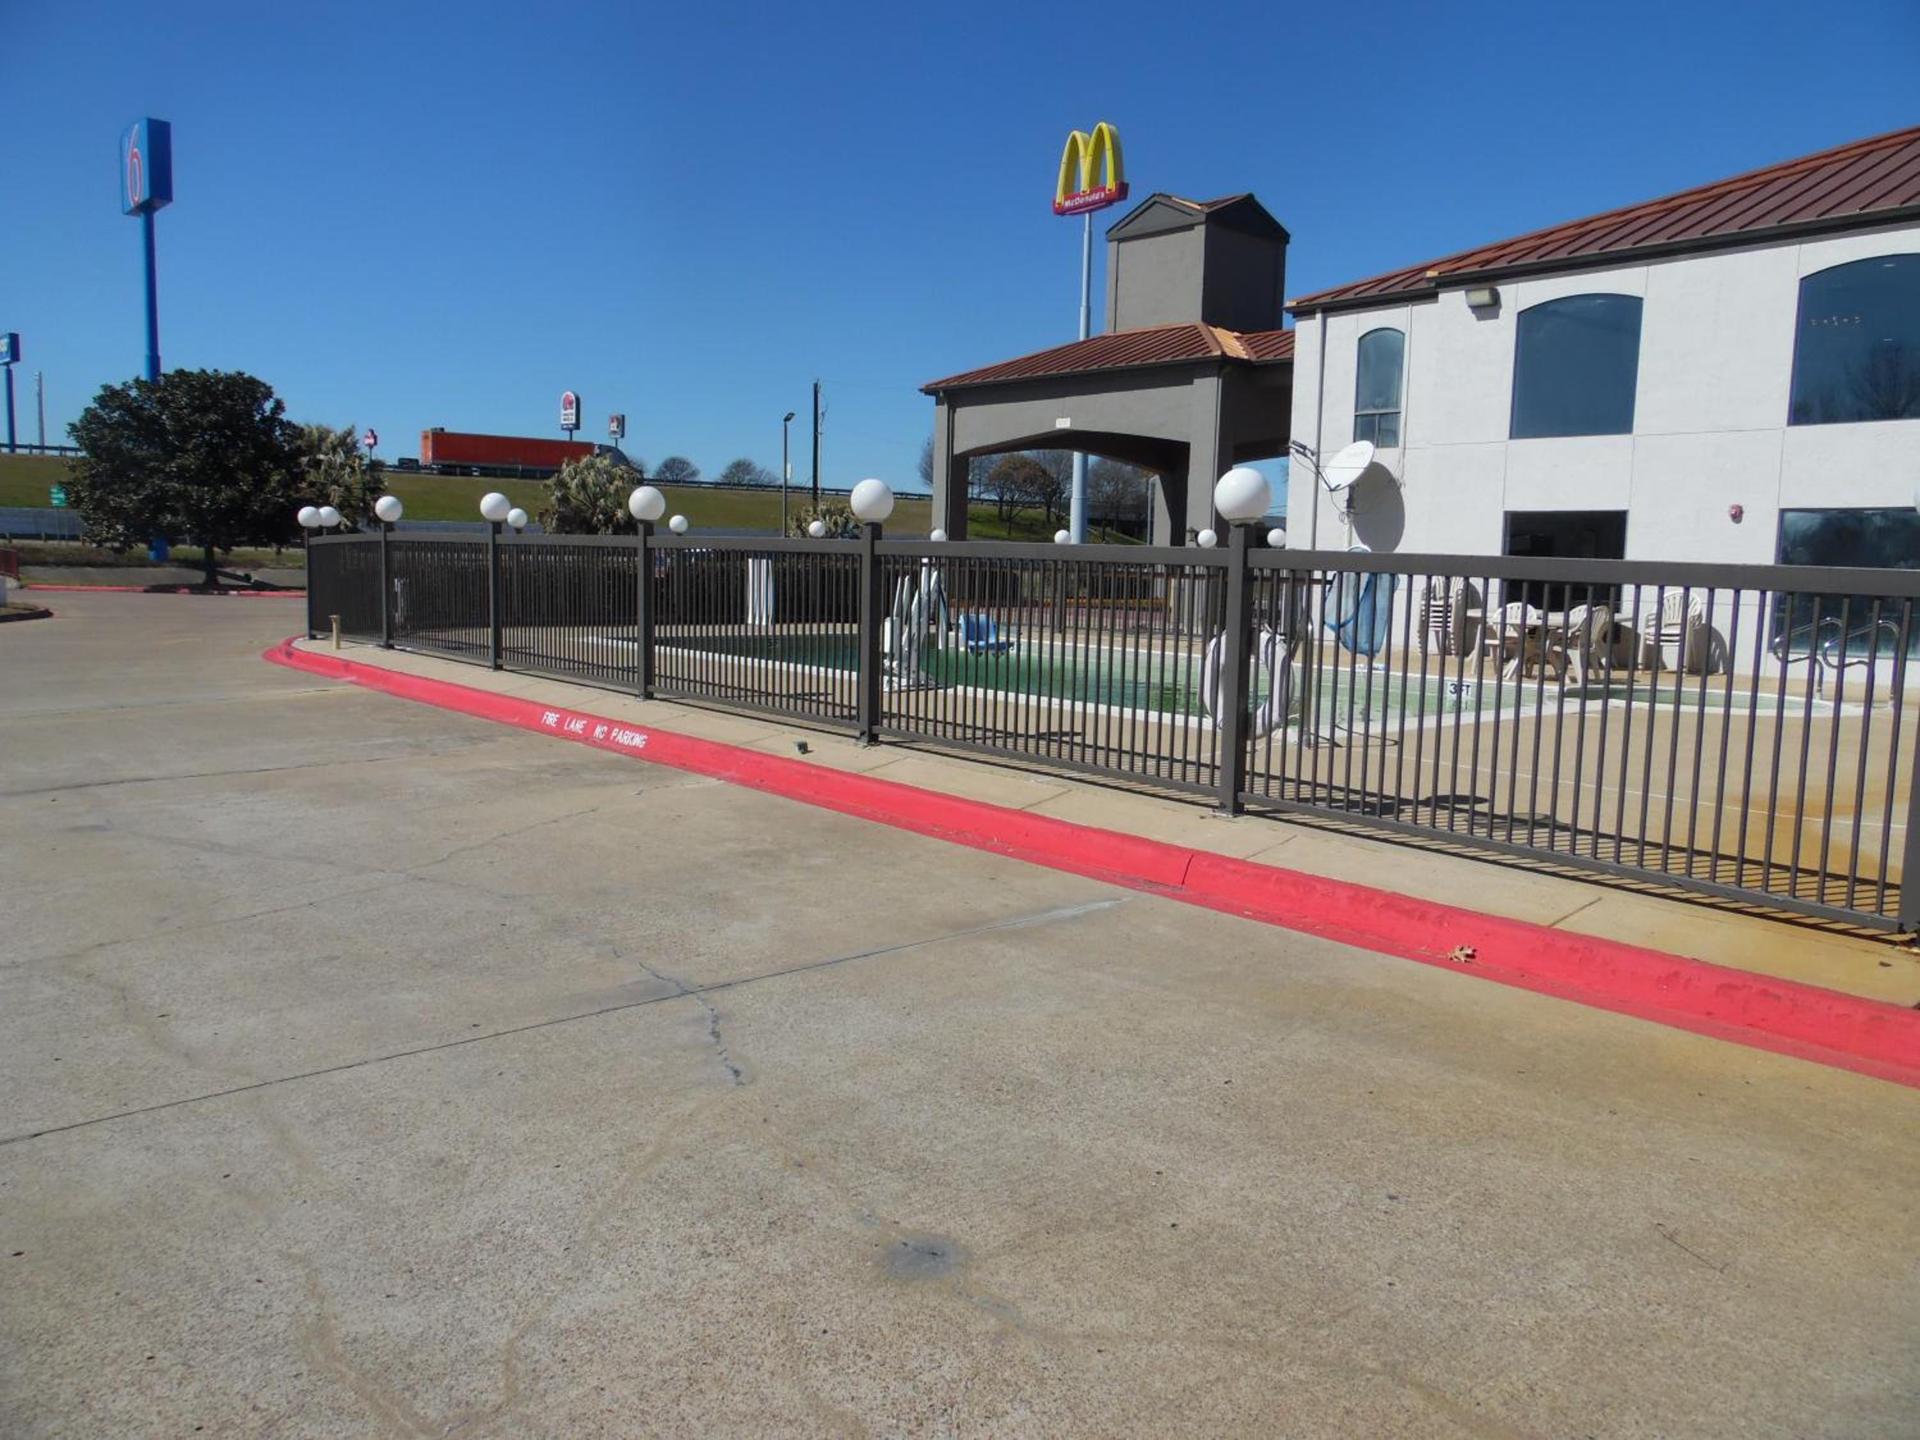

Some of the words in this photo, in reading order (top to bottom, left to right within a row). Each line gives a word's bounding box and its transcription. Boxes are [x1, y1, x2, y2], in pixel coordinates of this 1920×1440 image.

[1064, 192, 1105, 207] McDonald's
[541, 711, 560, 727] FIRE
[564, 716, 588, 734] LANE
[610, 727, 649, 748] PARKING
